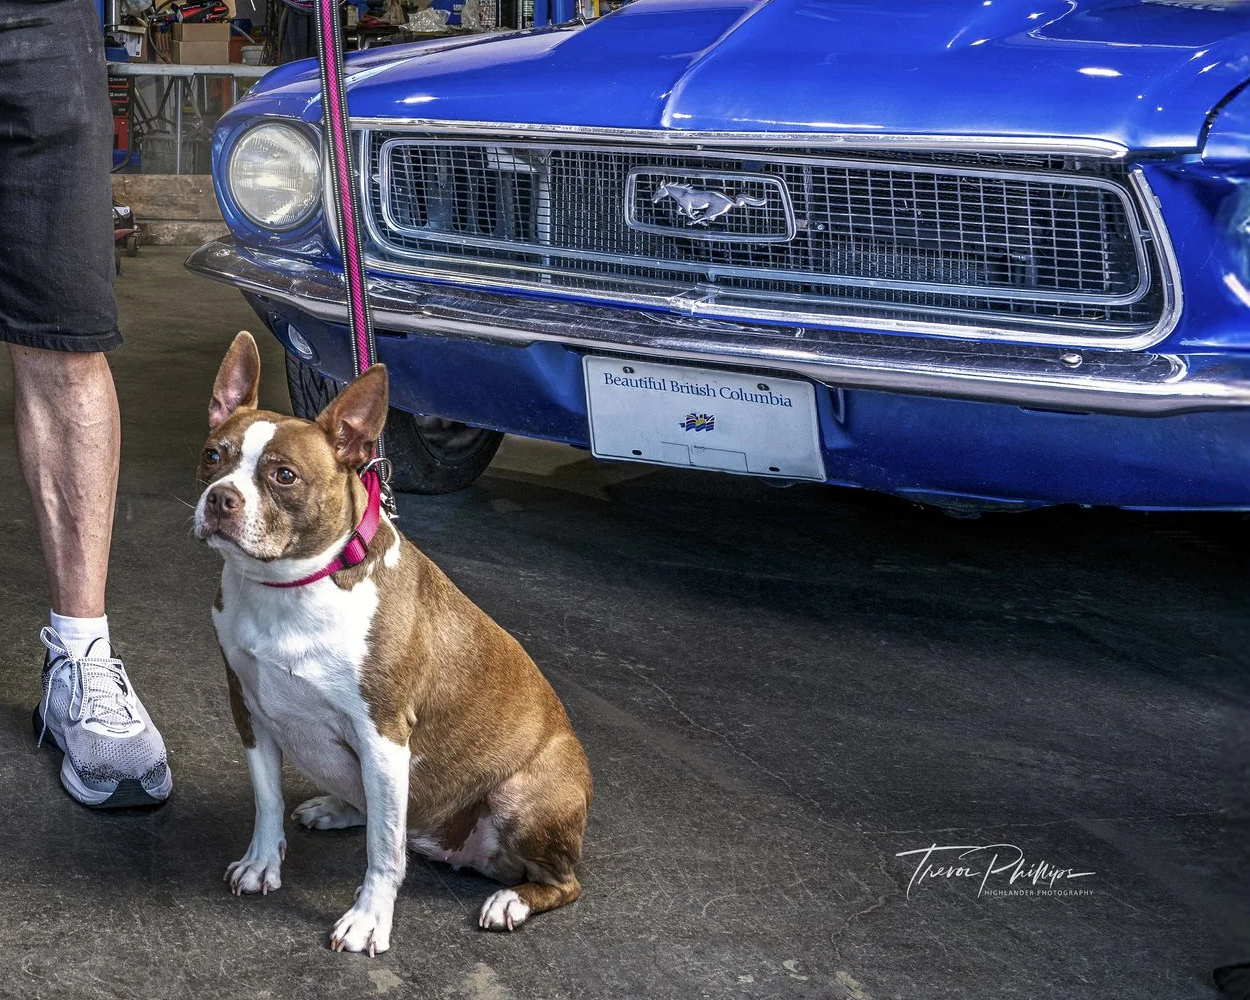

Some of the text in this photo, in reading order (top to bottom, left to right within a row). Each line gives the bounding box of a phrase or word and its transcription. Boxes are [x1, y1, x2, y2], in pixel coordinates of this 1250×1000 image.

[604, 372, 793, 408] Beautiful British Columbia
